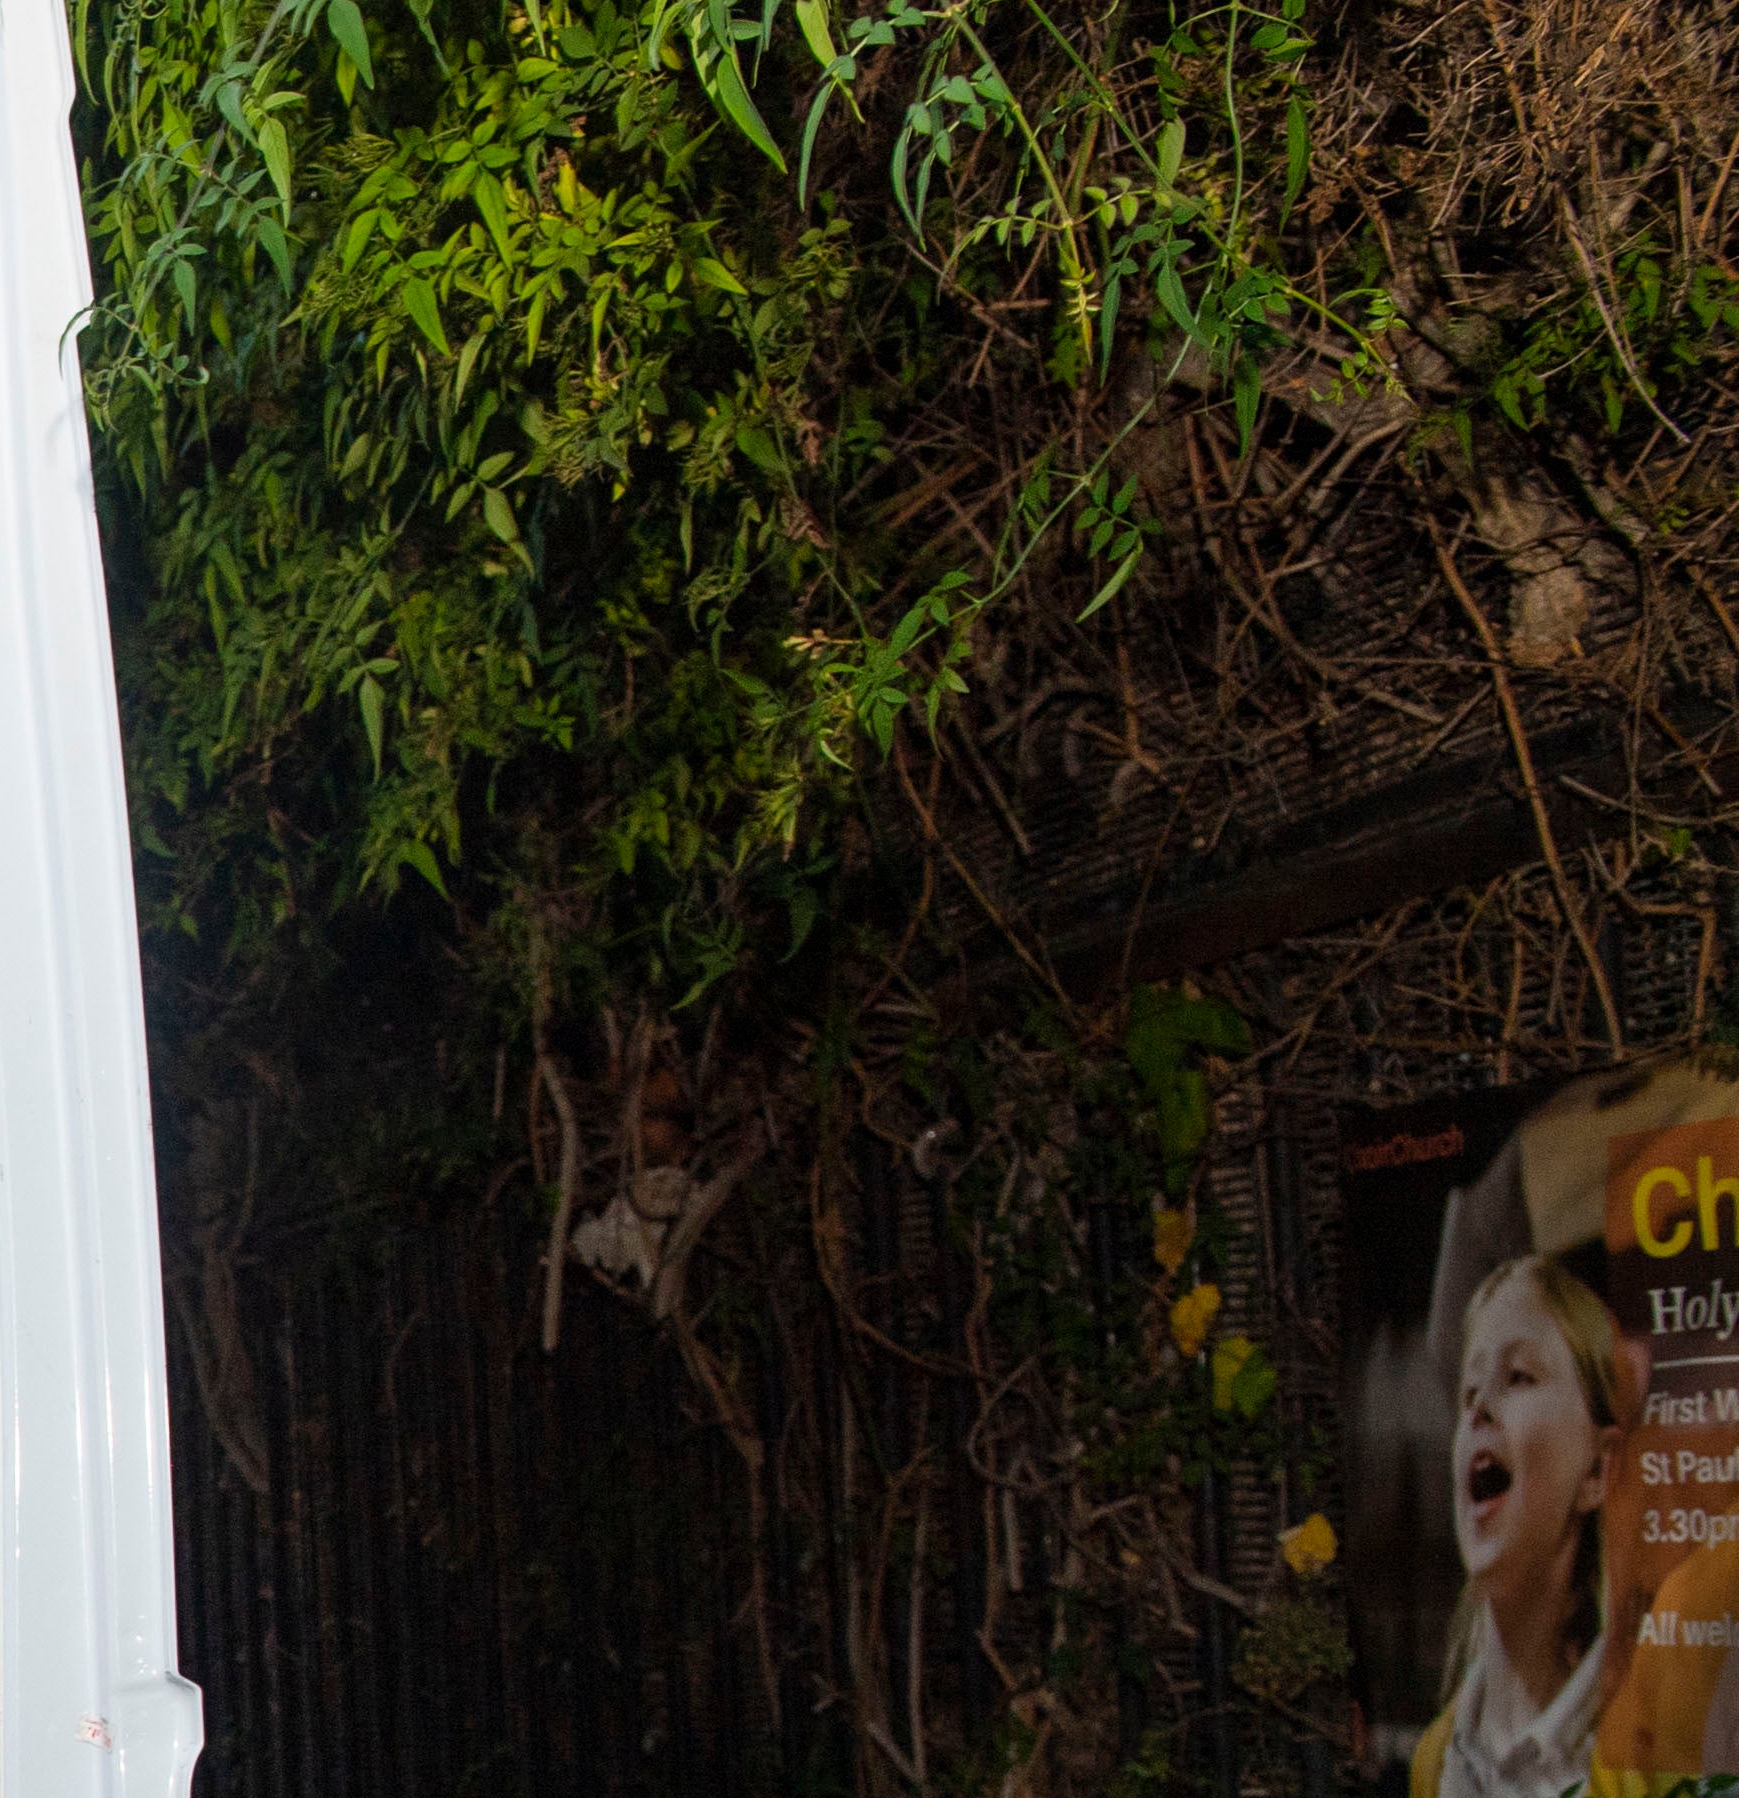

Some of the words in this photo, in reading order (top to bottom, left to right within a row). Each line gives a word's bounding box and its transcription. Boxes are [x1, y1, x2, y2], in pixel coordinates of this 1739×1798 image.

[1647, 1278, 1739, 1341] Holy
[1643, 1390, 1708, 1426] First
[1640, 1451, 1674, 1486] St
[1636, 1611, 1679, 1646] All
